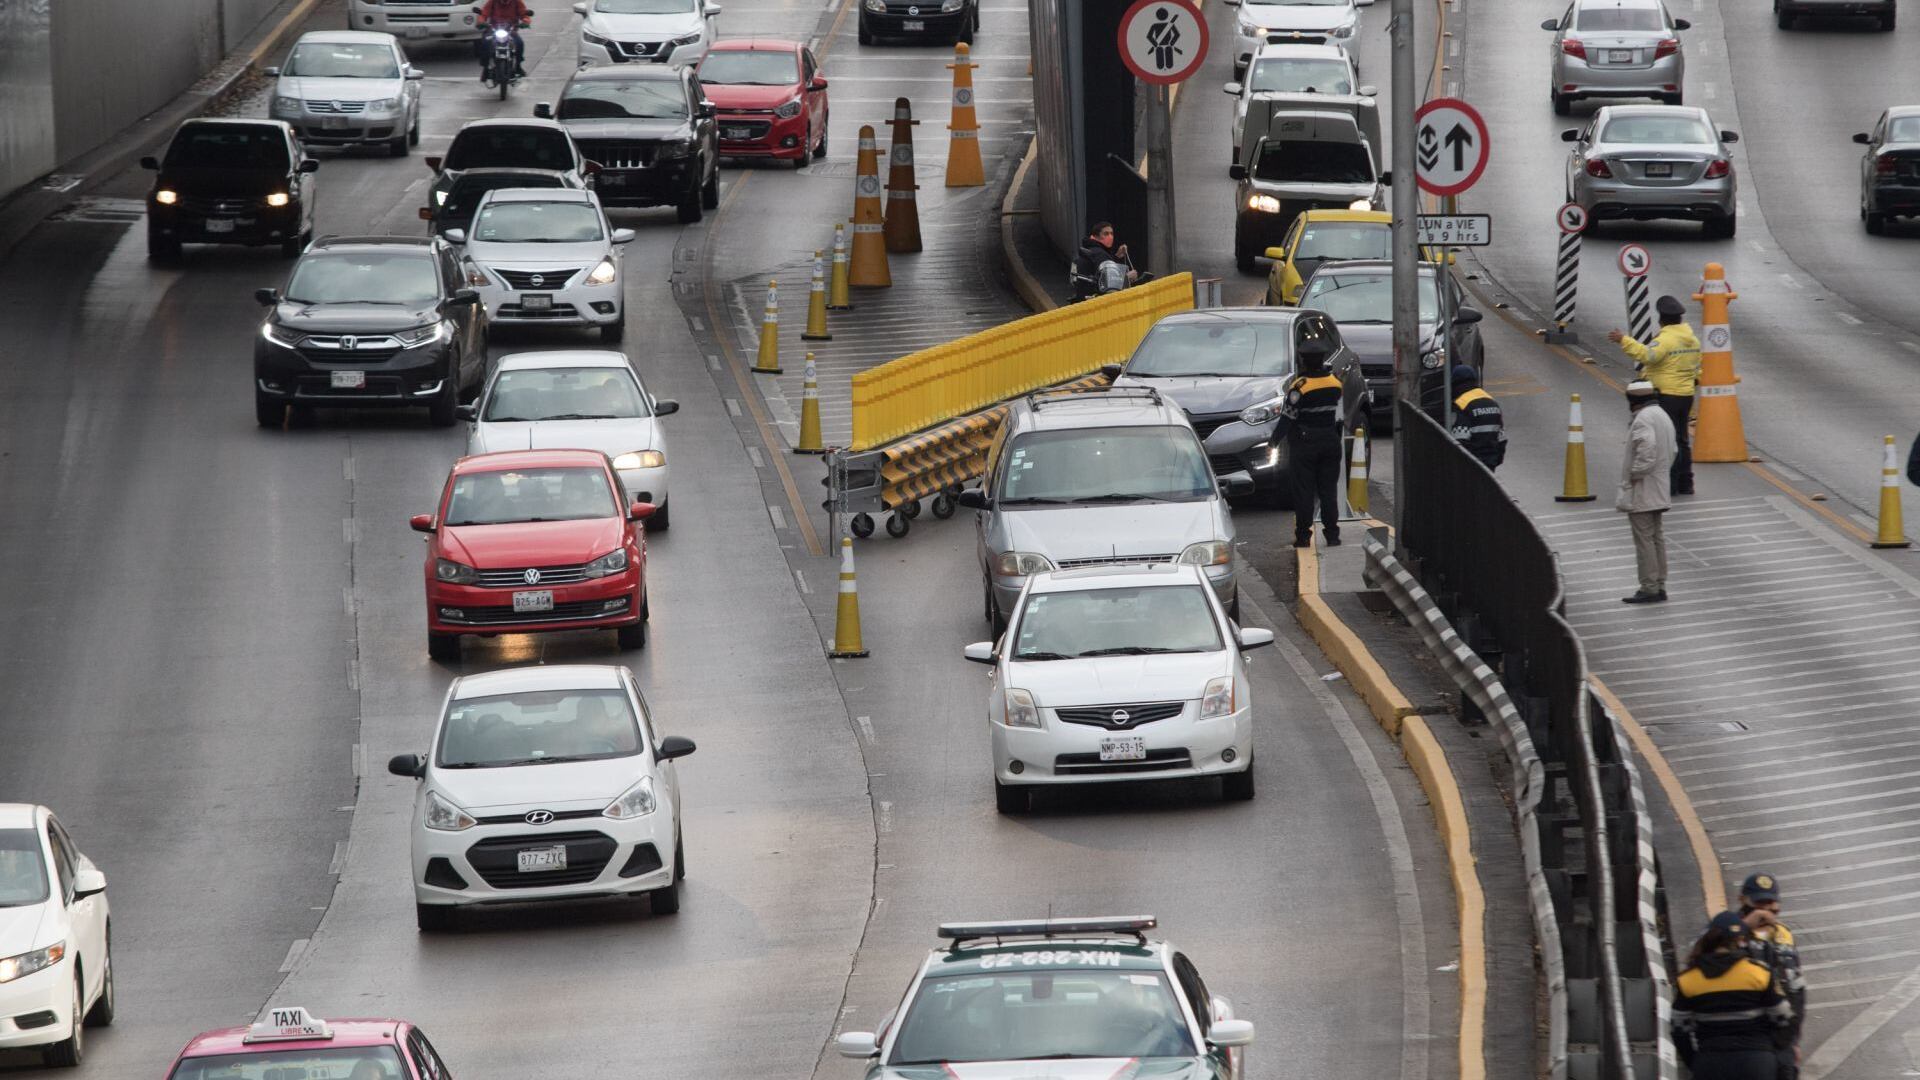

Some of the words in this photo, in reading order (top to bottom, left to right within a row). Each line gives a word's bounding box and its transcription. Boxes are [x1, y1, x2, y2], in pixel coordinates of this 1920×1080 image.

[1418, 219, 1442, 229] LUN
[1446, 221, 1453, 229] a
[1456, 219, 1475, 229] VIE
[1428, 233, 1434, 241] a
[1442, 231, 1449, 241] 9
[1457, 231, 1479, 241] hrs
[1101, 742, 1144, 753] NMP-53-15
[521, 852, 562, 865] 877-ZXC
[273, 1010, 302, 1027] TAXI
[281, 1027, 303, 1035] LIBRE
